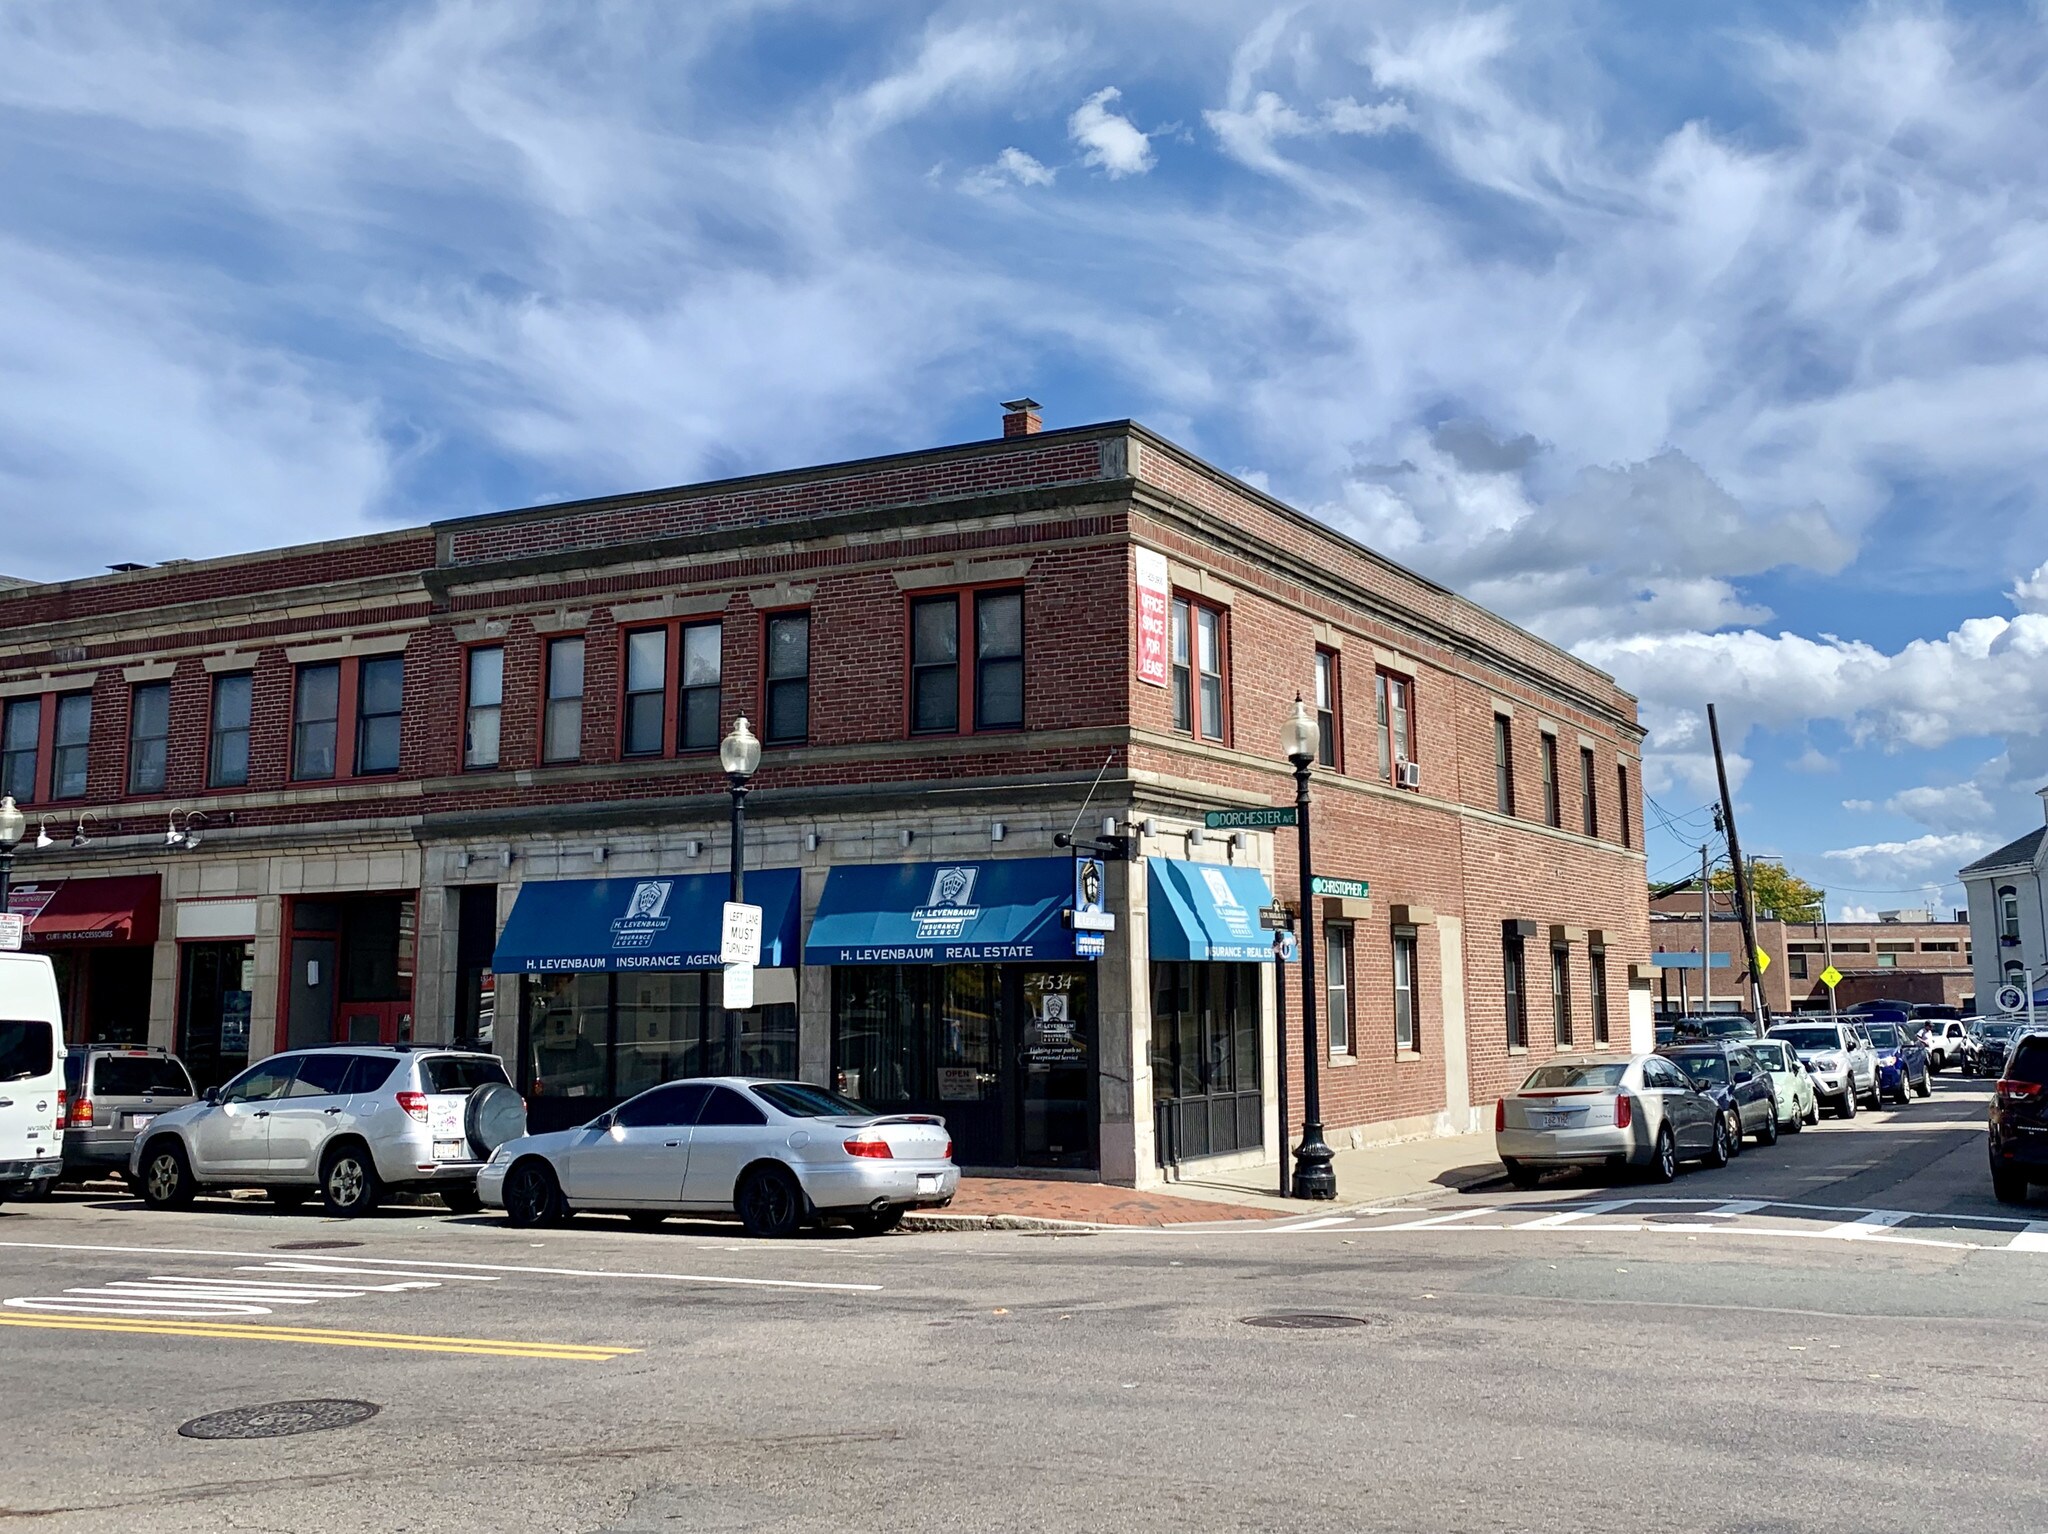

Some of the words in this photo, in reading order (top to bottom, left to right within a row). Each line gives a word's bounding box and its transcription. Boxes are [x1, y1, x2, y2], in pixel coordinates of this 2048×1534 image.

[1141, 593, 1164, 614] OFFICE
[1142, 615, 1163, 635] SPACE
[1146, 637, 1160, 655] FOR
[1142, 658, 1163, 678] LEASE
[1220, 811, 1281, 826] DORCHESTER
[1282, 814, 1294, 825] AVE
[1321, 879, 1363, 897] CHRISTOPHER
[729, 911, 743, 922] LEFT
[745, 914, 759, 925] LANE
[926, 908, 976, 917] LEVENBAUM
[78, 931, 113, 939] ACCESSORIES
[730, 926, 754, 940] MUST
[726, 942, 740, 953] TURN
[741, 945, 754, 955] LEFT
[840, 950, 852, 961] H.
[856, 948, 933, 960] LEVENBAUM
[946, 947, 980, 958] REAL
[984, 946, 1034, 957] ESTATE
[1247, 947, 1262, 958] REAL
[526, 959, 537, 969] H.
[540, 957, 605, 969] LEVENBAUM
[616, 955, 680, 967] INSURANCE
[686, 954, 724, 966] AGENC
[1039, 975, 1072, 990] 1534
[945, 1070, 970, 1078] OPEN
